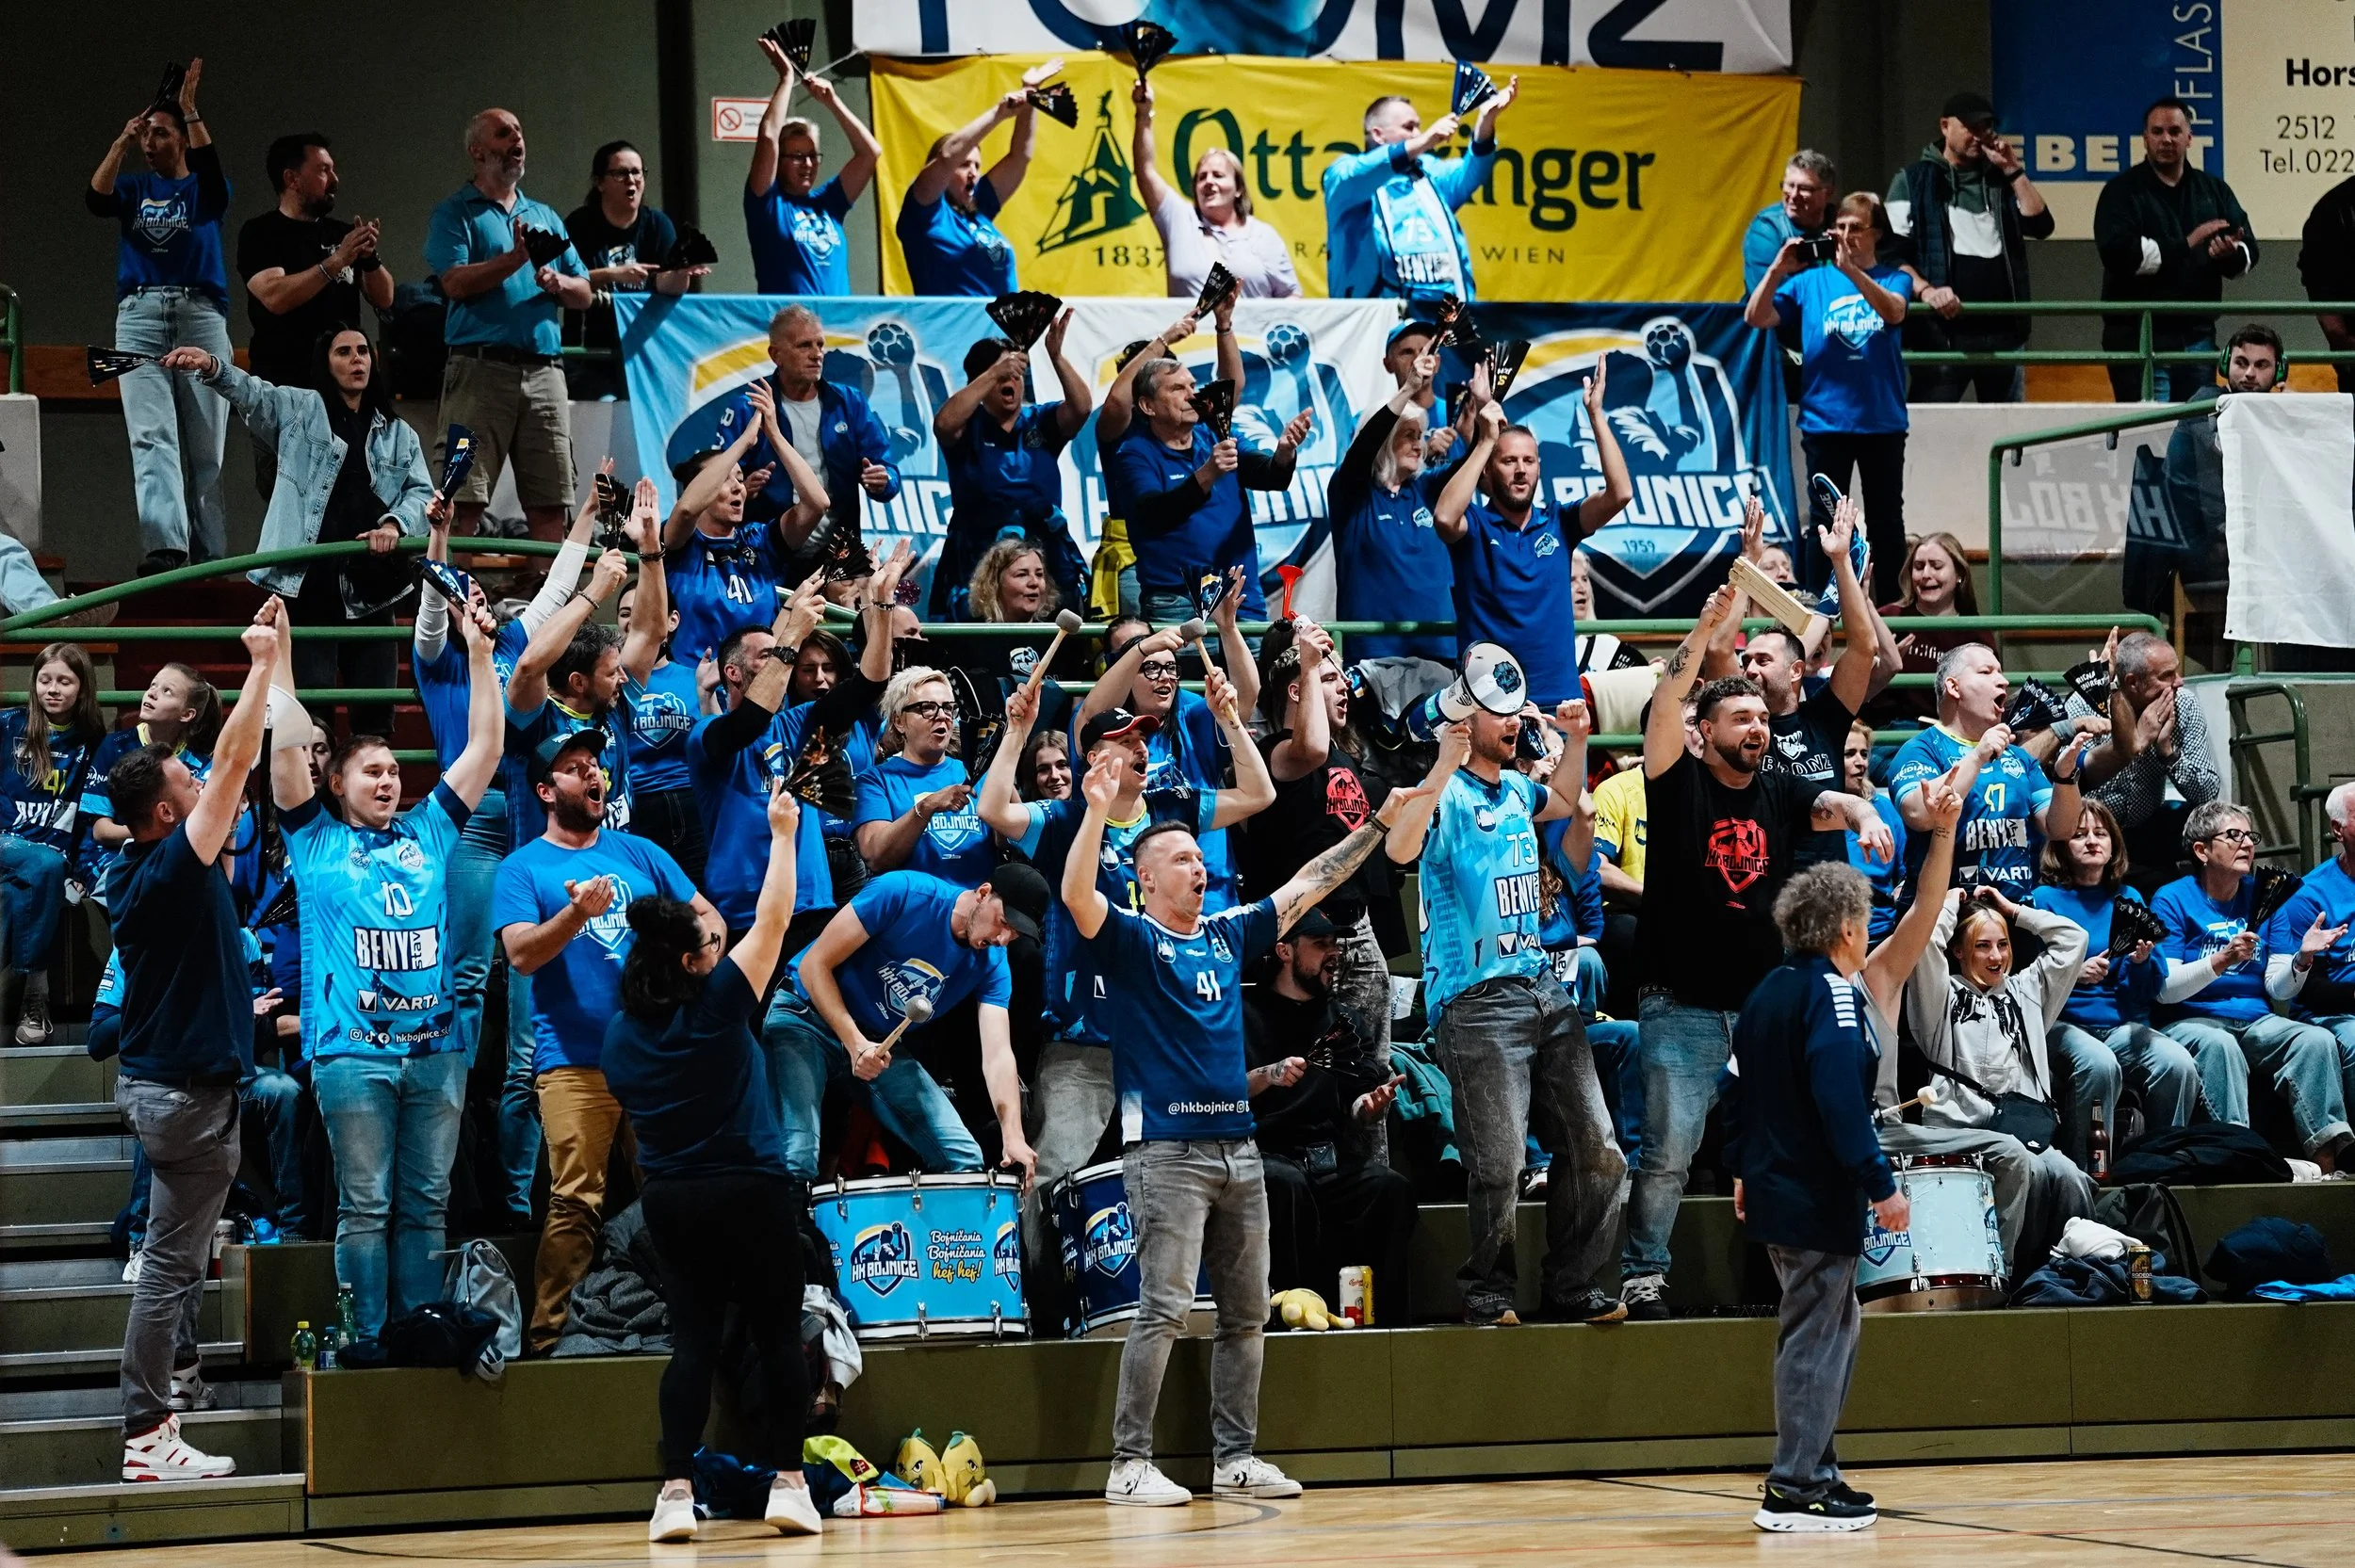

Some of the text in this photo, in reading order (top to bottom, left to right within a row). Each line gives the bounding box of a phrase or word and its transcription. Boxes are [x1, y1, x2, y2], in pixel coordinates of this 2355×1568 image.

[2277, 115, 2335, 139] 2512
[1173, 107, 1655, 233] Ottnger
[1402, 218, 1434, 243] 73
[1483, 246, 1566, 265] WIEN
[1622, 539, 1656, 554] 1959
[726, 574, 754, 604] 41
[640, 715, 690, 731] BOJNICE
[932, 815, 980, 832] BOJNICE
[1506, 833, 1536, 867] 73
[381, 881, 414, 917] 10
[356, 928, 412, 971] BENY
[412, 931, 424, 970] stav
[1196, 969, 1222, 1001] 41
[382, 994, 439, 1012] VARTA
[1168, 1100, 1235, 1115] @hkbojnice
[930, 1229, 983, 1244] Bojničania
[1863, 1230, 1910, 1252] BOJNICE
[927, 1245, 986, 1261] Bojničania
[1085, 1248, 1097, 1269] HK
[1097, 1238, 1137, 1260] BOJNIC
[852, 1259, 918, 1282] HK BOJNICE
[933, 1260, 954, 1285] hej
[956, 1260, 983, 1285] hej!
